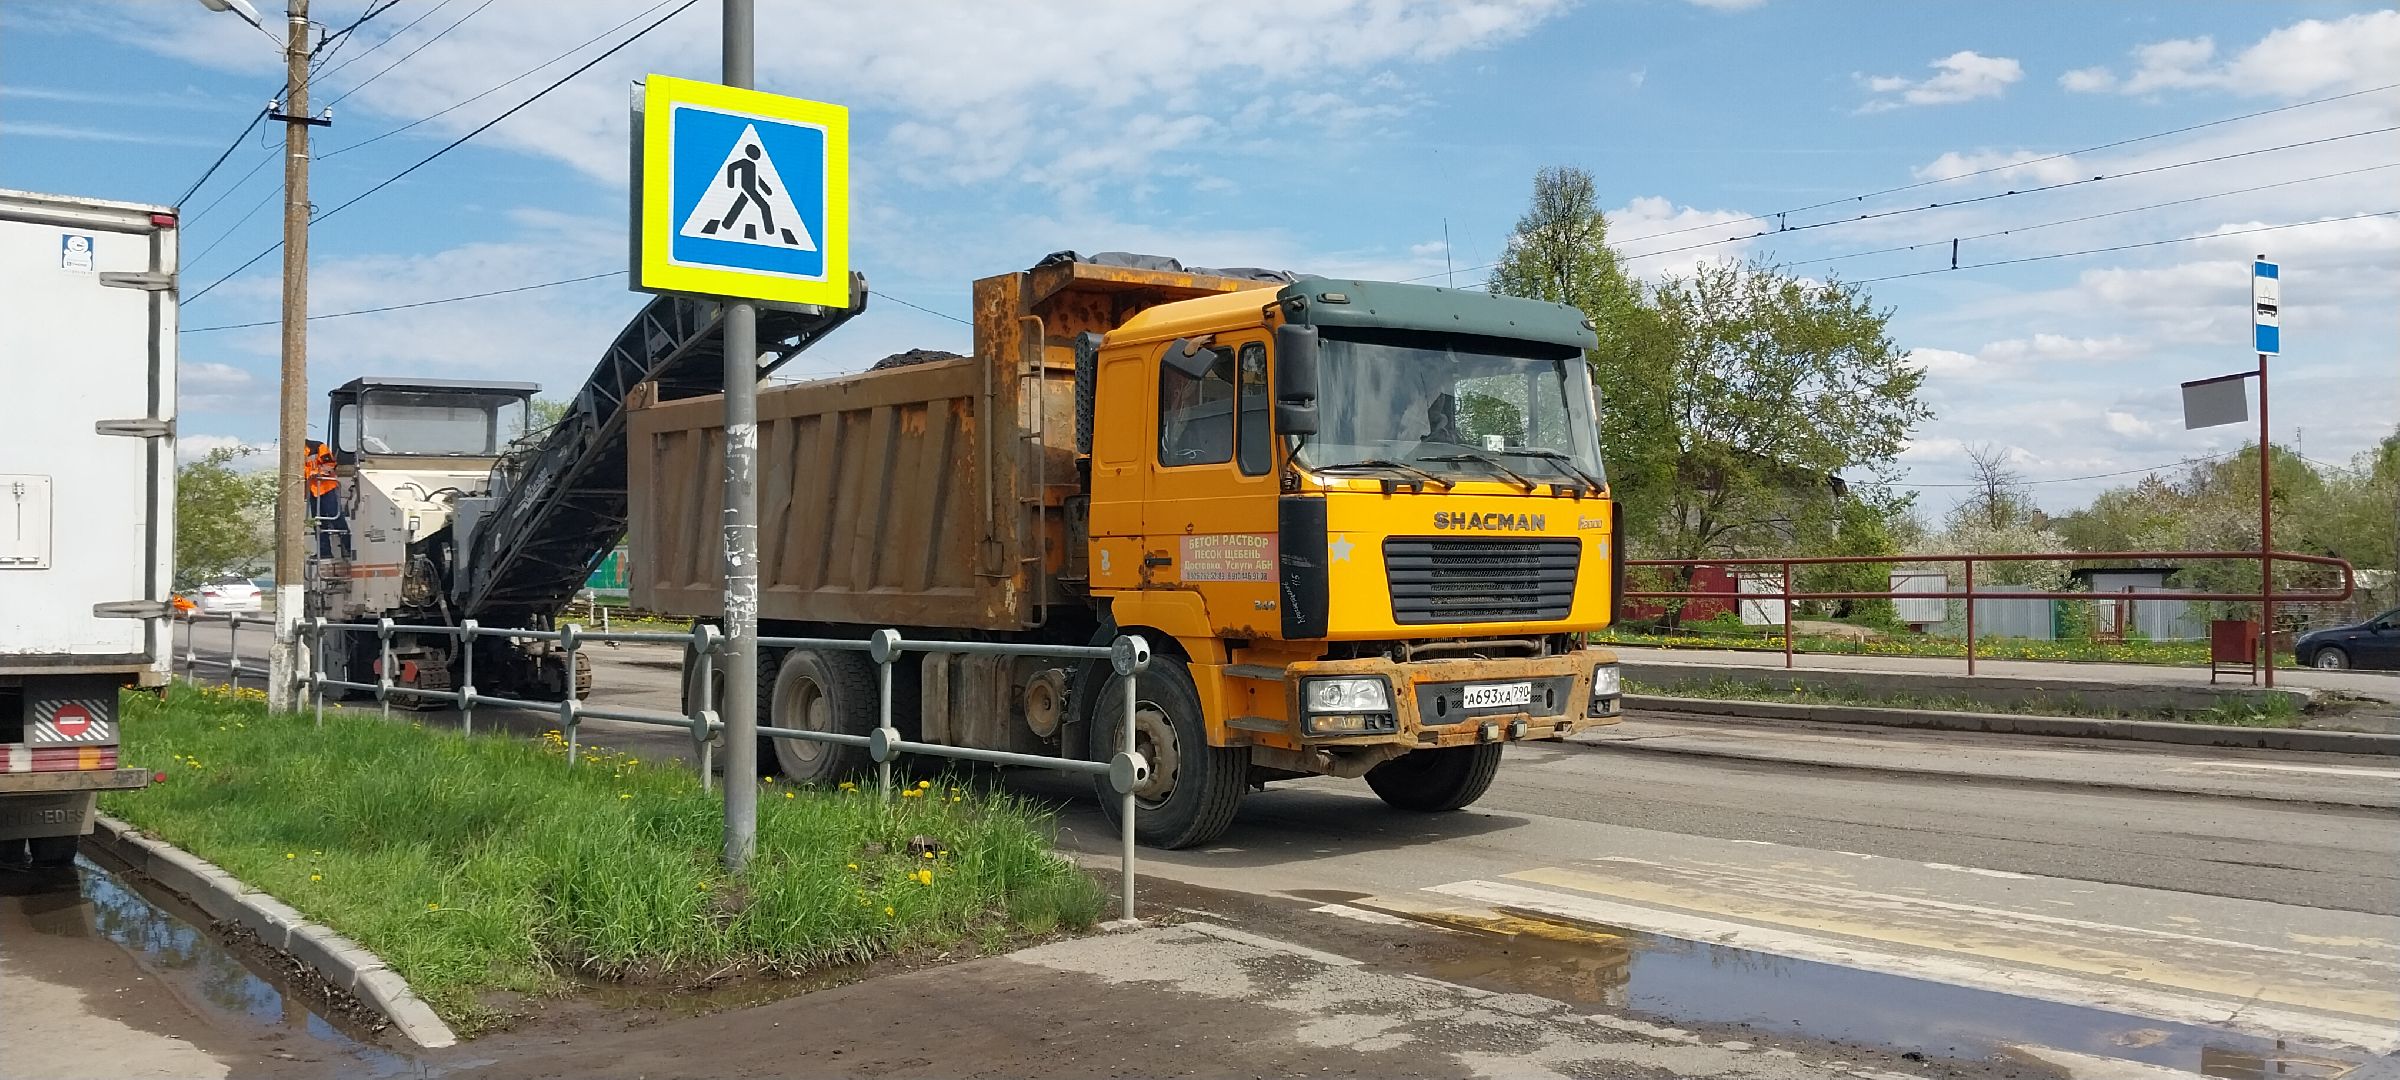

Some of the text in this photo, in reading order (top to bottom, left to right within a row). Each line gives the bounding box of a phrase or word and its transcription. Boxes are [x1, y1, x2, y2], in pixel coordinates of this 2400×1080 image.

[1433, 511, 1546, 531] SHACMAN
[1189, 535, 1269, 550] БЕТОН РАСТВОР
[1194, 549, 1261, 561] ПЕСОК ЩЕБЕНЬ
[1224, 560, 1254, 572] Услуги
[1255, 560, 1273, 571] АБН
[1467, 685, 1530, 705] А693ХА 790
